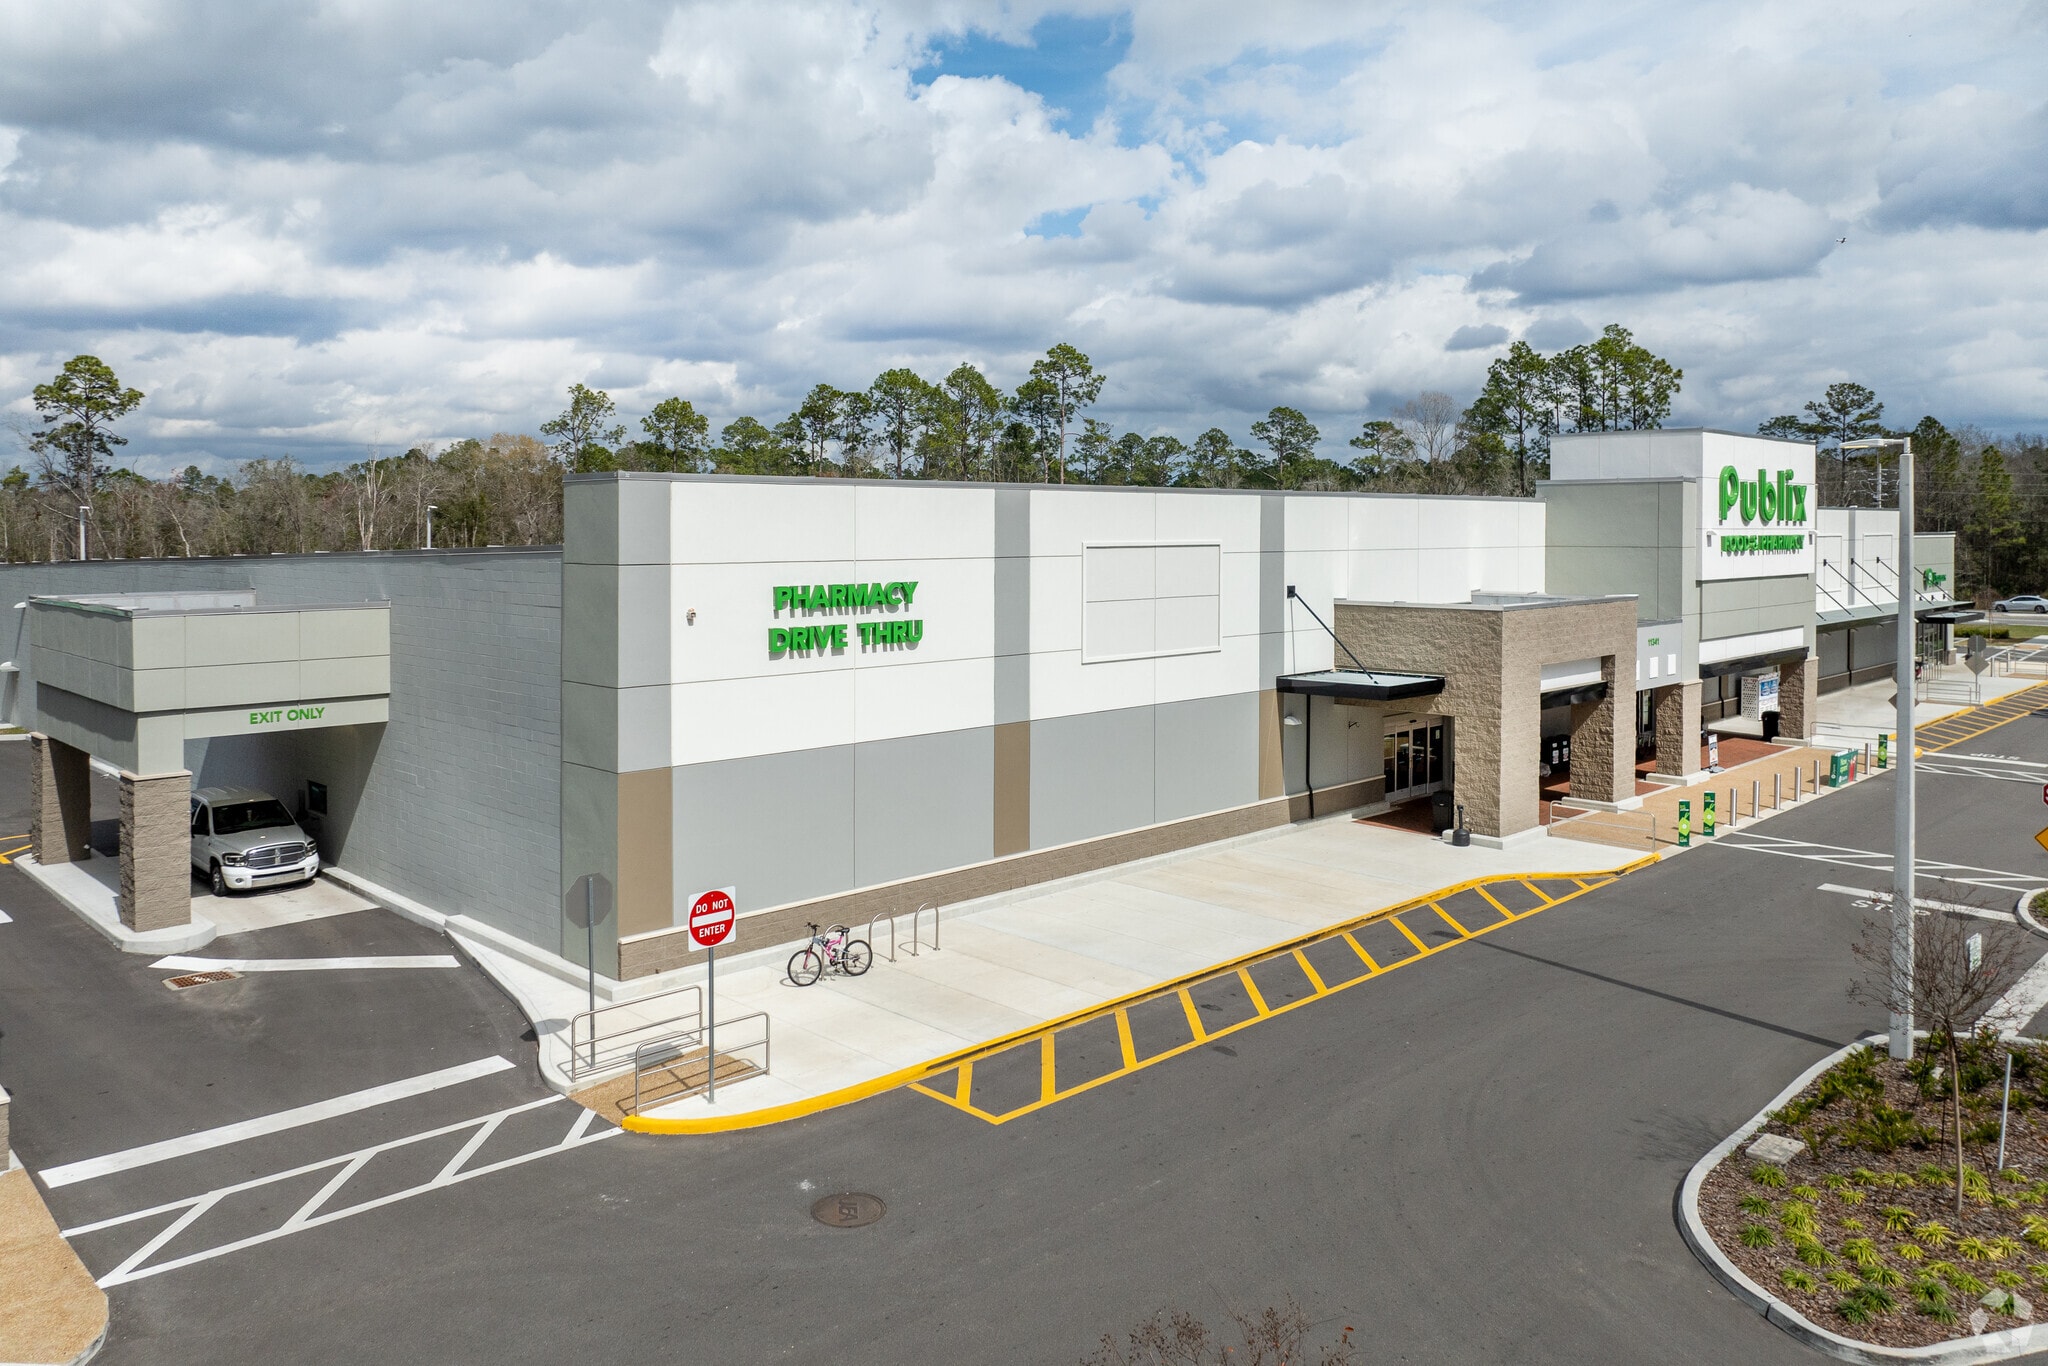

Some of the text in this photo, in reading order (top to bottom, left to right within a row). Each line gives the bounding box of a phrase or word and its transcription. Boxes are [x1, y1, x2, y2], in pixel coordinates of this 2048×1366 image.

[1719, 465, 1807, 522] Publix
[1721, 535, 1749, 552] FOOD
[1758, 535, 1805, 550] PHARMACY
[773, 581, 919, 611] PHARMACY
[768, 619, 924, 653] DRIVE THRU
[250, 707, 325, 725] EXIT ONLY
[696, 898, 729, 914] DO NOT
[1851, 900, 1931, 916] STP
[699, 924, 726, 938] ENTER
